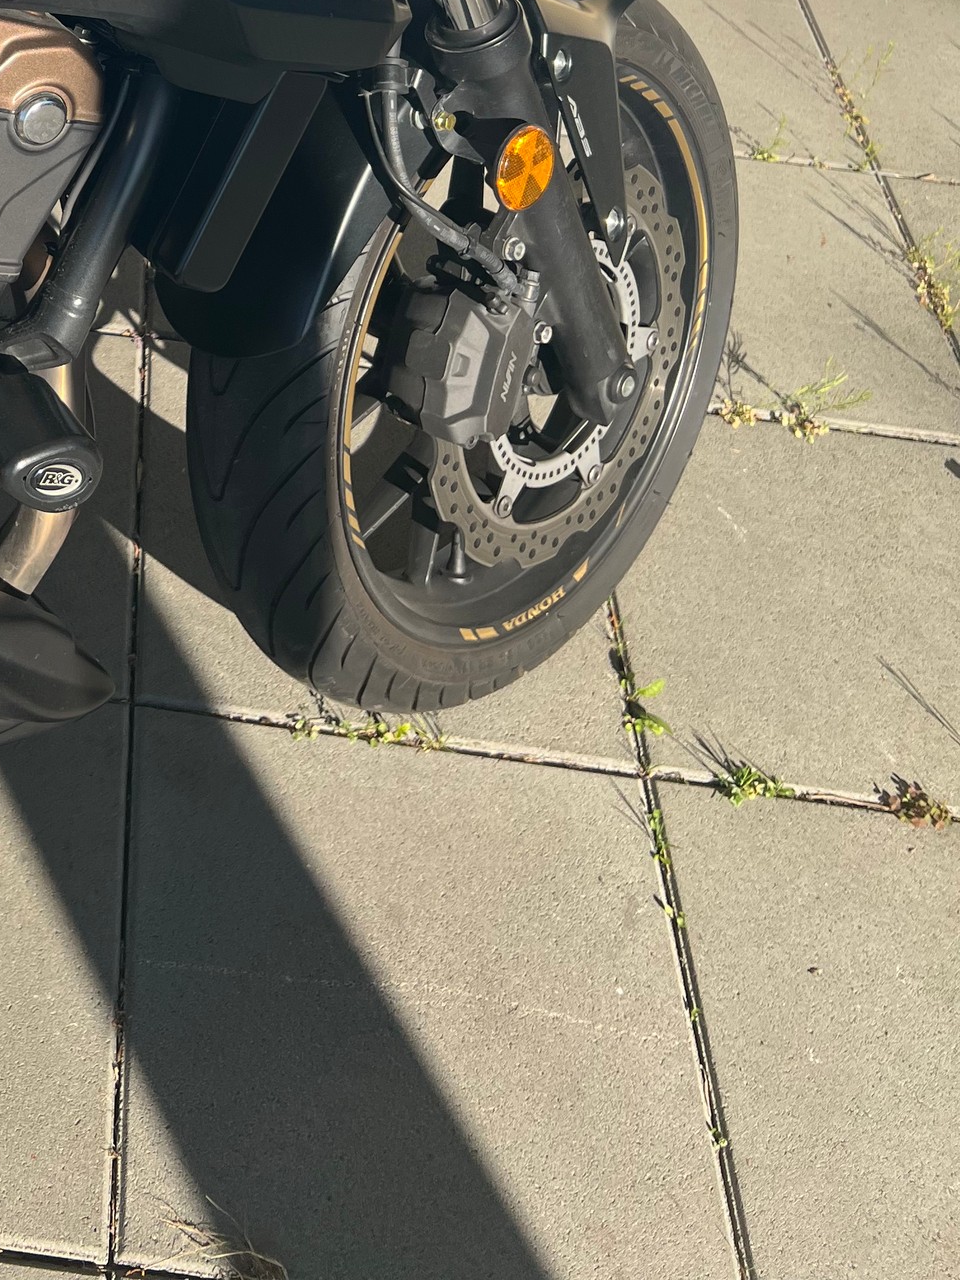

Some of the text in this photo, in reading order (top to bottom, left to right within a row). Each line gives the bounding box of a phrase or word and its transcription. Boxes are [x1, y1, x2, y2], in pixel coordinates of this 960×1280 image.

[567, 94, 593, 157] ABS
[500, 350, 517, 403] NISSIN
[41, 472, 75, 486] R&G
[502, 585, 566, 631] HONDA
